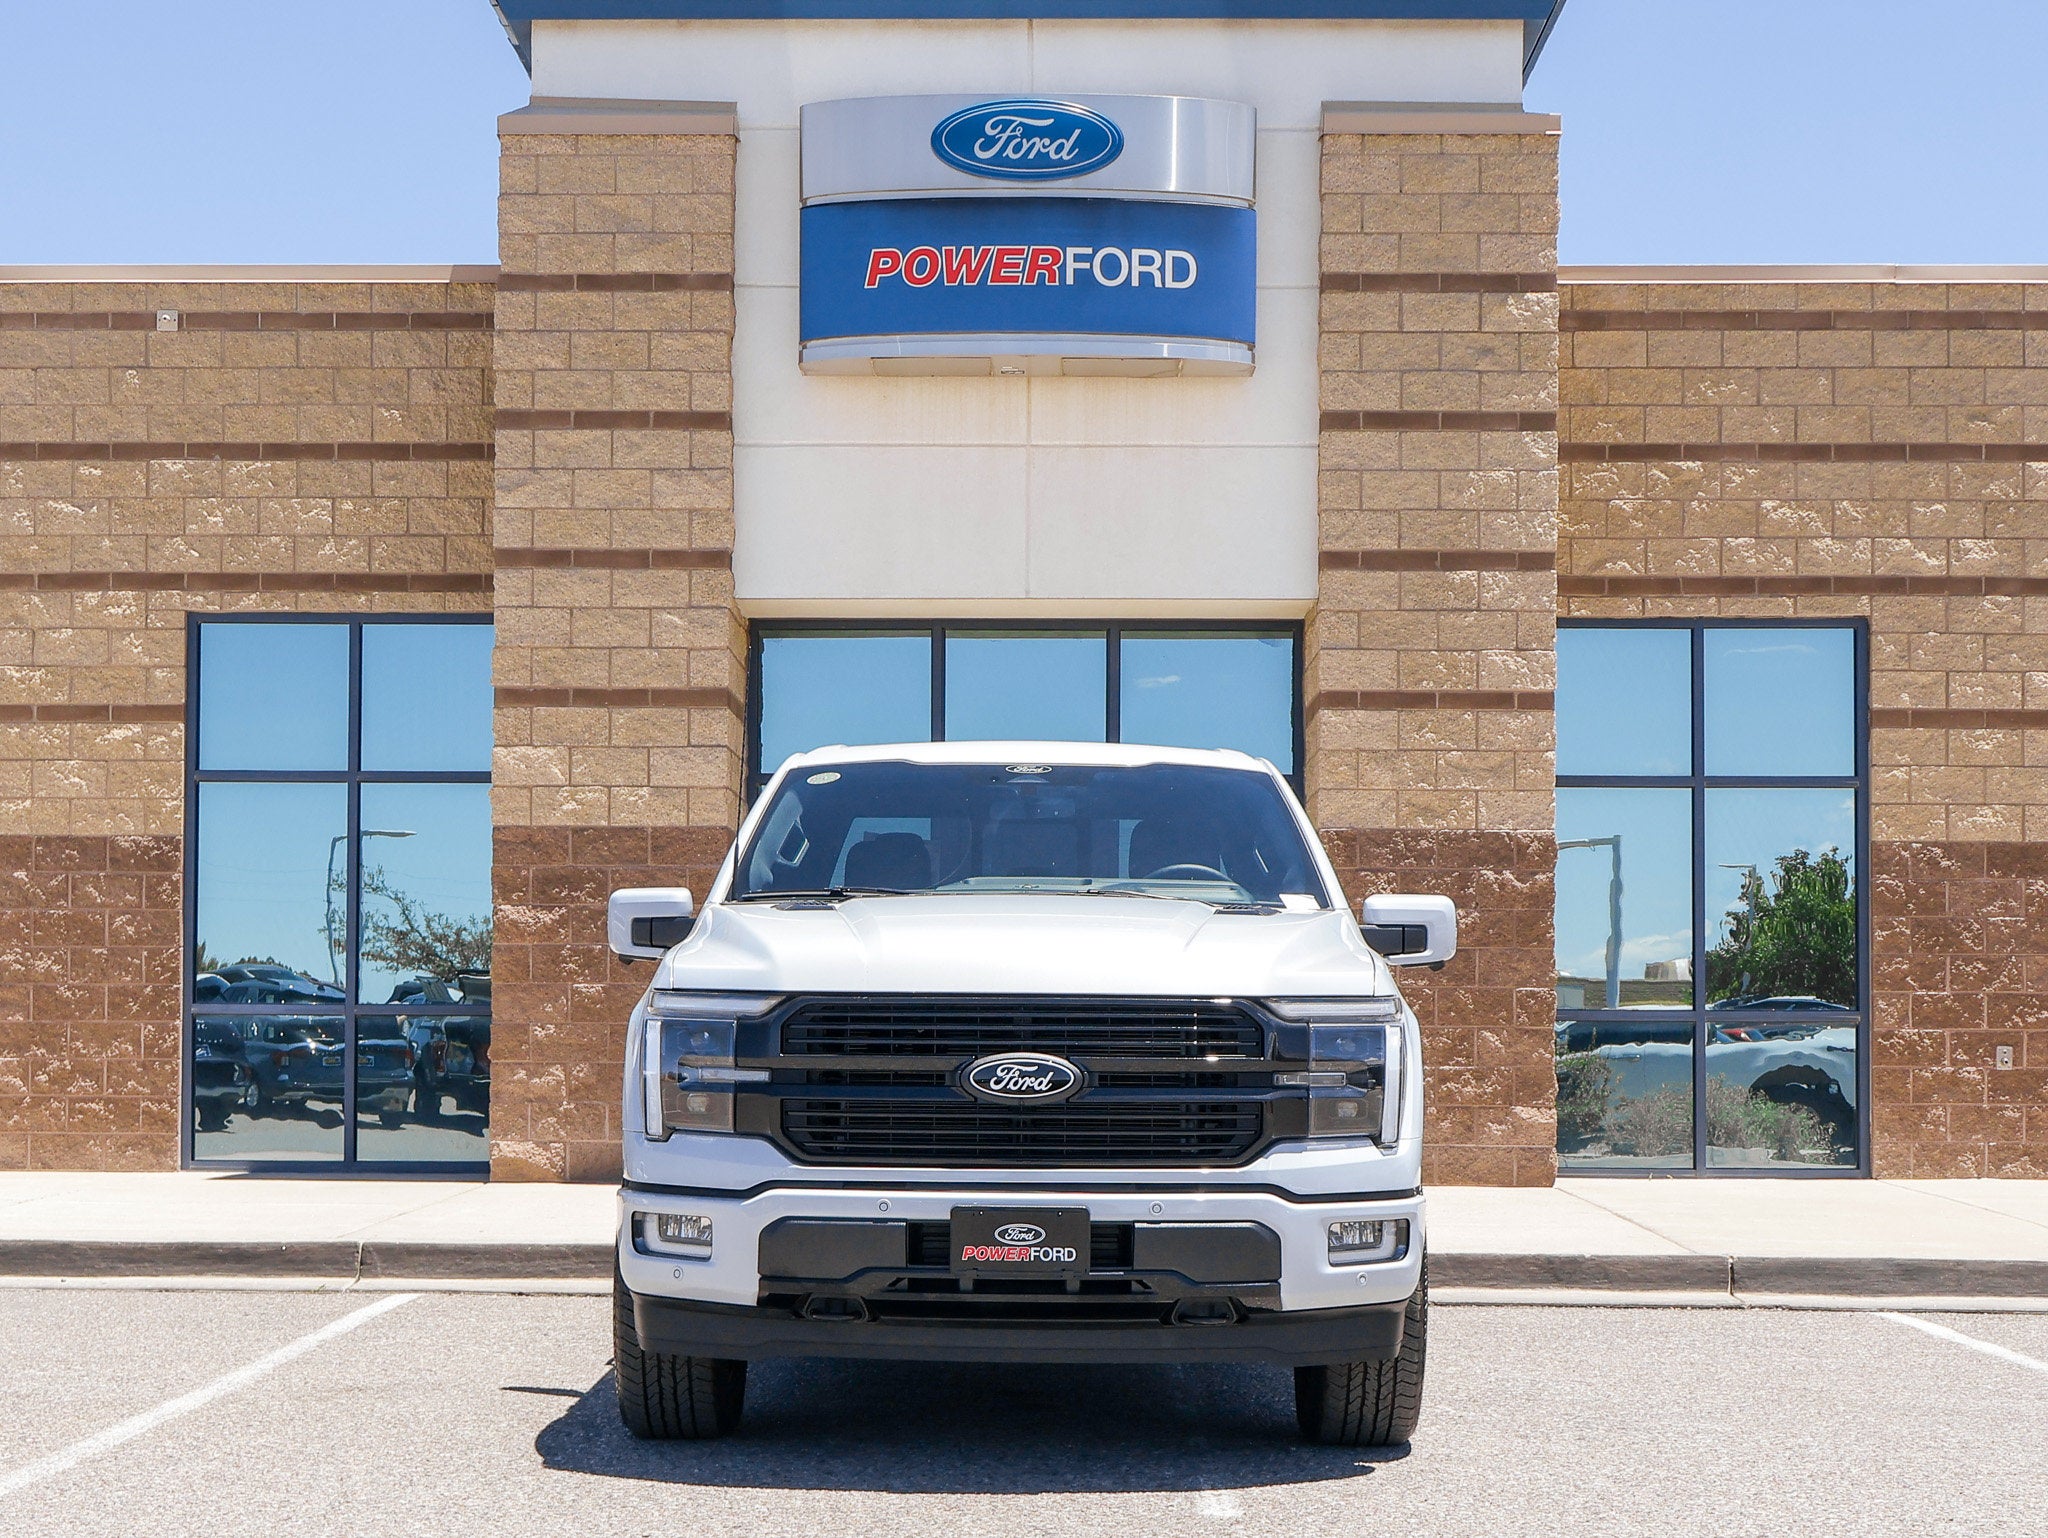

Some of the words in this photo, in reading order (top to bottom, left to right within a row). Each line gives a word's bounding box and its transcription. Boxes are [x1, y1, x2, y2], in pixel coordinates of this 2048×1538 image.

[974, 115, 1080, 161] Ford
[990, 1064, 1054, 1091] Ford
[1004, 1227, 1035, 1241] Ford
